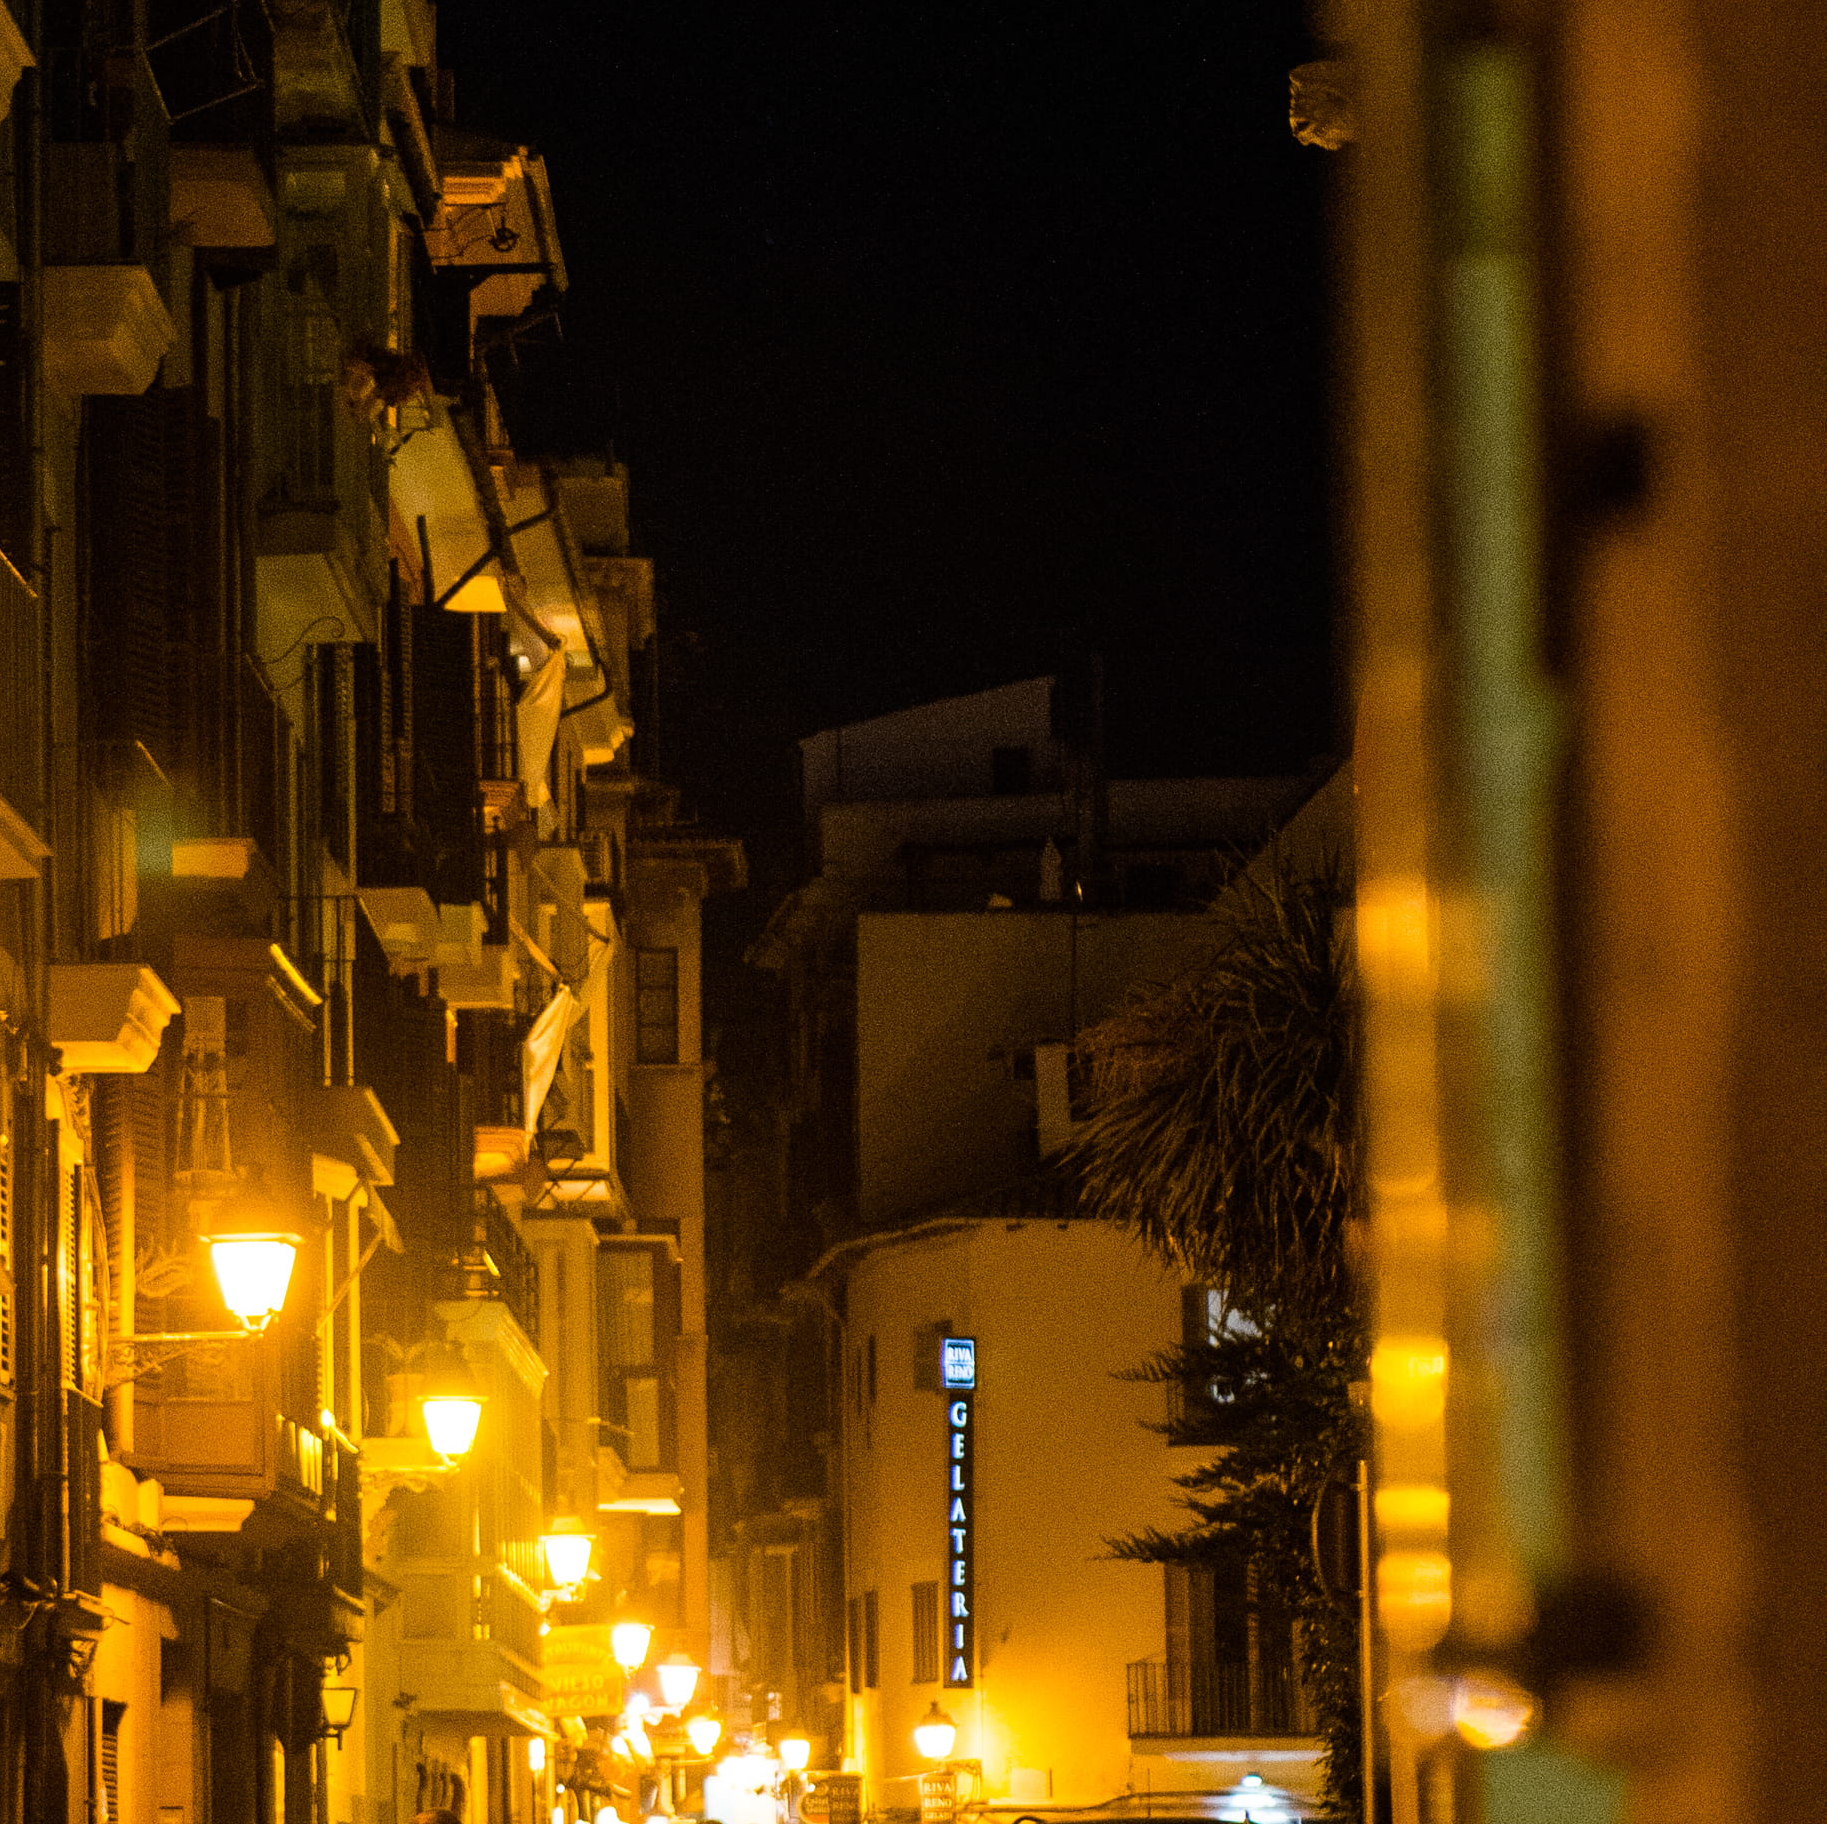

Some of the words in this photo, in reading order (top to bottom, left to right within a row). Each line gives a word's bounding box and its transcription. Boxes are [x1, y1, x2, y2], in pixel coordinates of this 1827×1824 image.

[948, 1347, 972, 1360] RIVA
[949, 1401, 969, 1682] GELATERIA
[924, 1782, 952, 1792] RIVA
[924, 1798, 952, 1808] RENO
